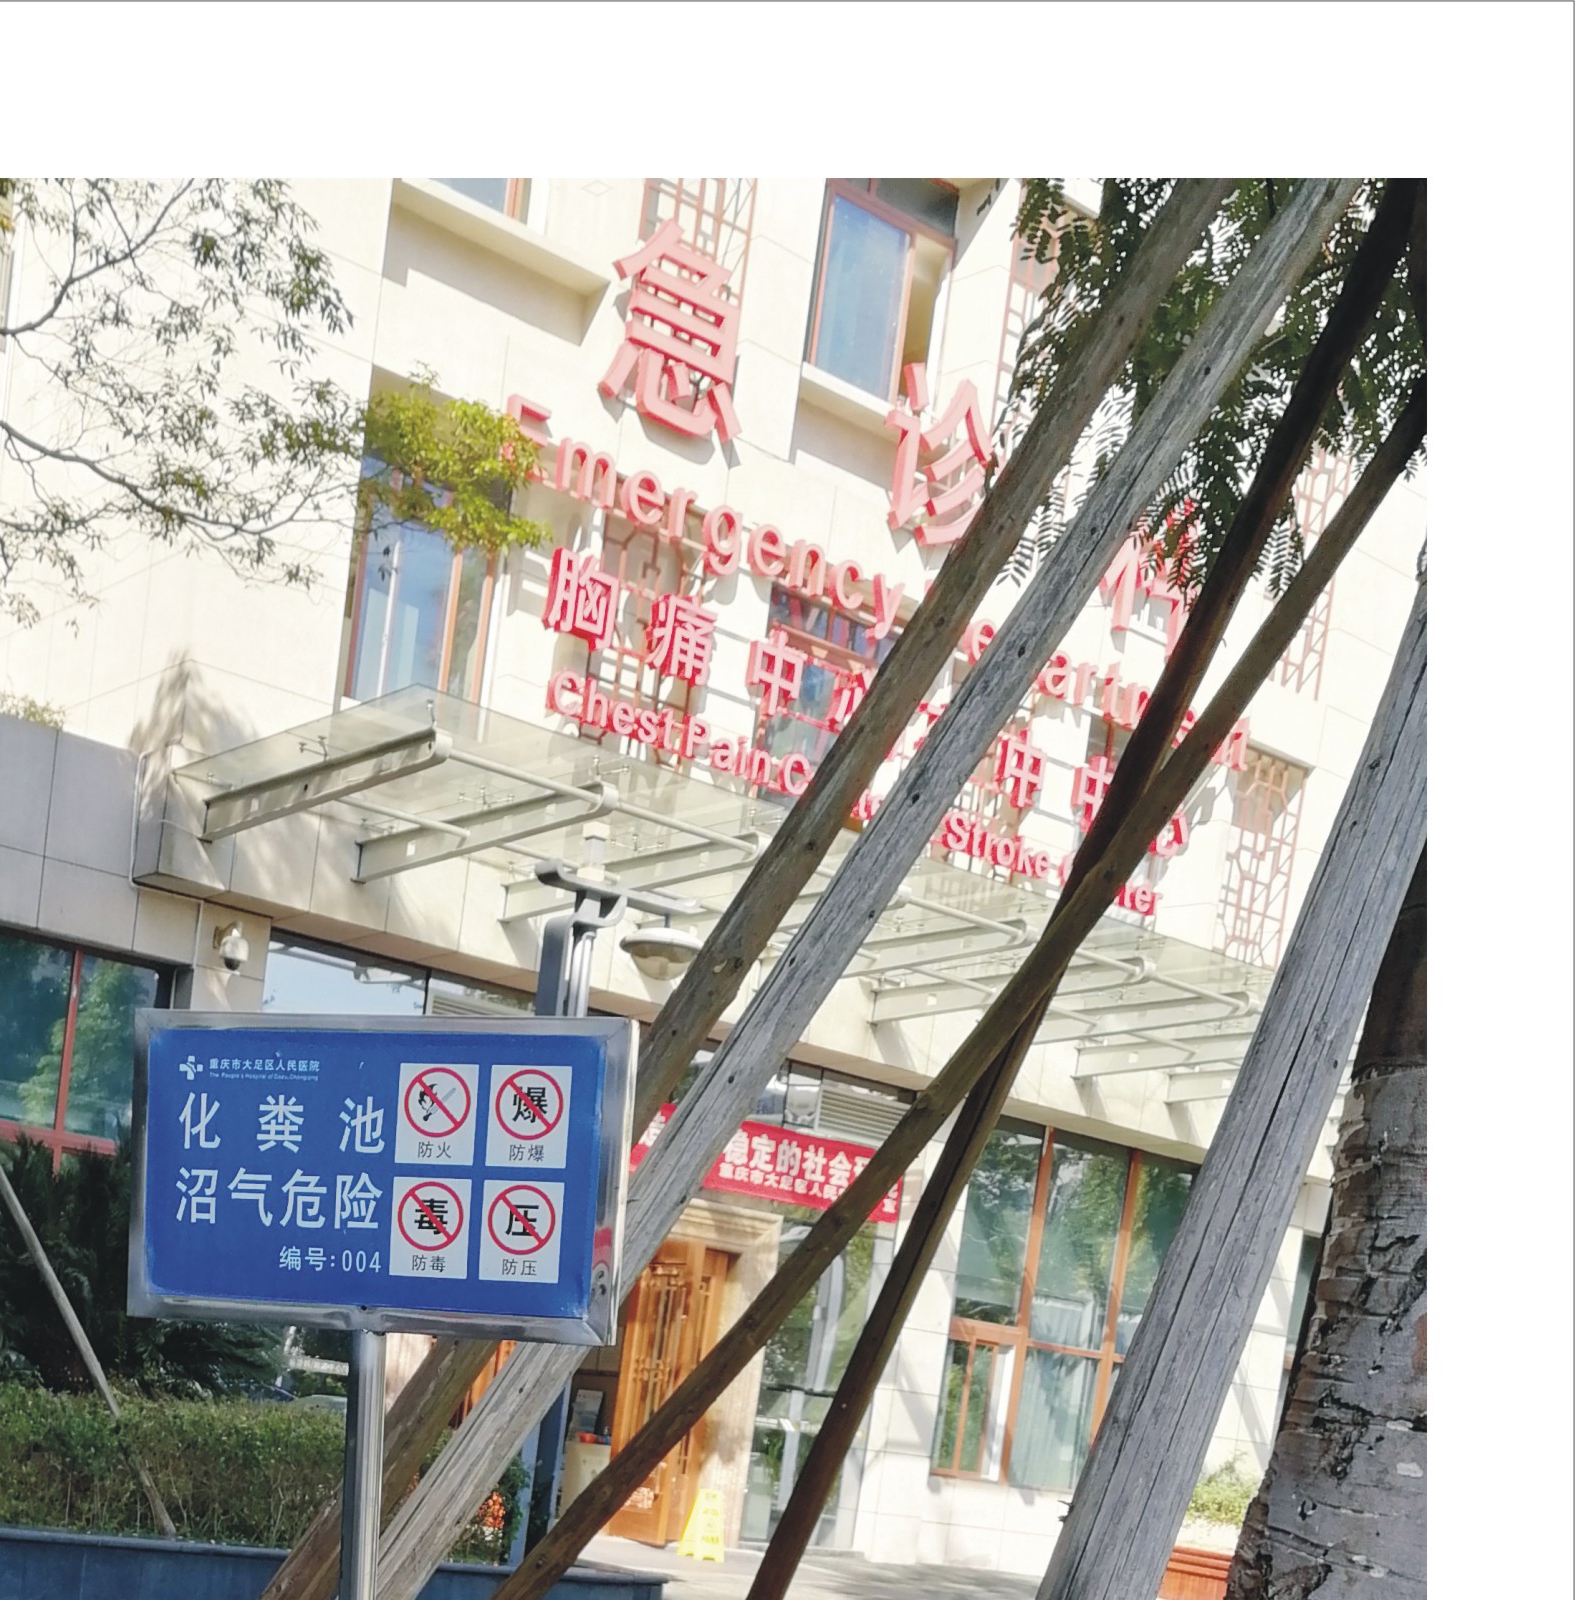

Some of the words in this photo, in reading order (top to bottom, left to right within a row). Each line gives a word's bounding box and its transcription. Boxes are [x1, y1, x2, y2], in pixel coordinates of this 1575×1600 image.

[547, 670, 675, 750] Chest
[676, 714, 774, 784] Pain
[941, 808, 1050, 880] Stroke
[209, 1057, 320, 1072] 重庆市大足区人民医院
[512, 1086, 548, 1123] 爆
[178, 1091, 386, 1155] 化粪池
[417, 1141, 453, 1159] 防火
[509, 1144, 545, 1163] 防爆
[175, 1166, 383, 1231] 沼气危险
[413, 1198, 448, 1235] 毒
[505, 1204, 540, 1237] 压
[411, 1254, 447, 1273] 防毒
[501, 1258, 538, 1277] 防压
